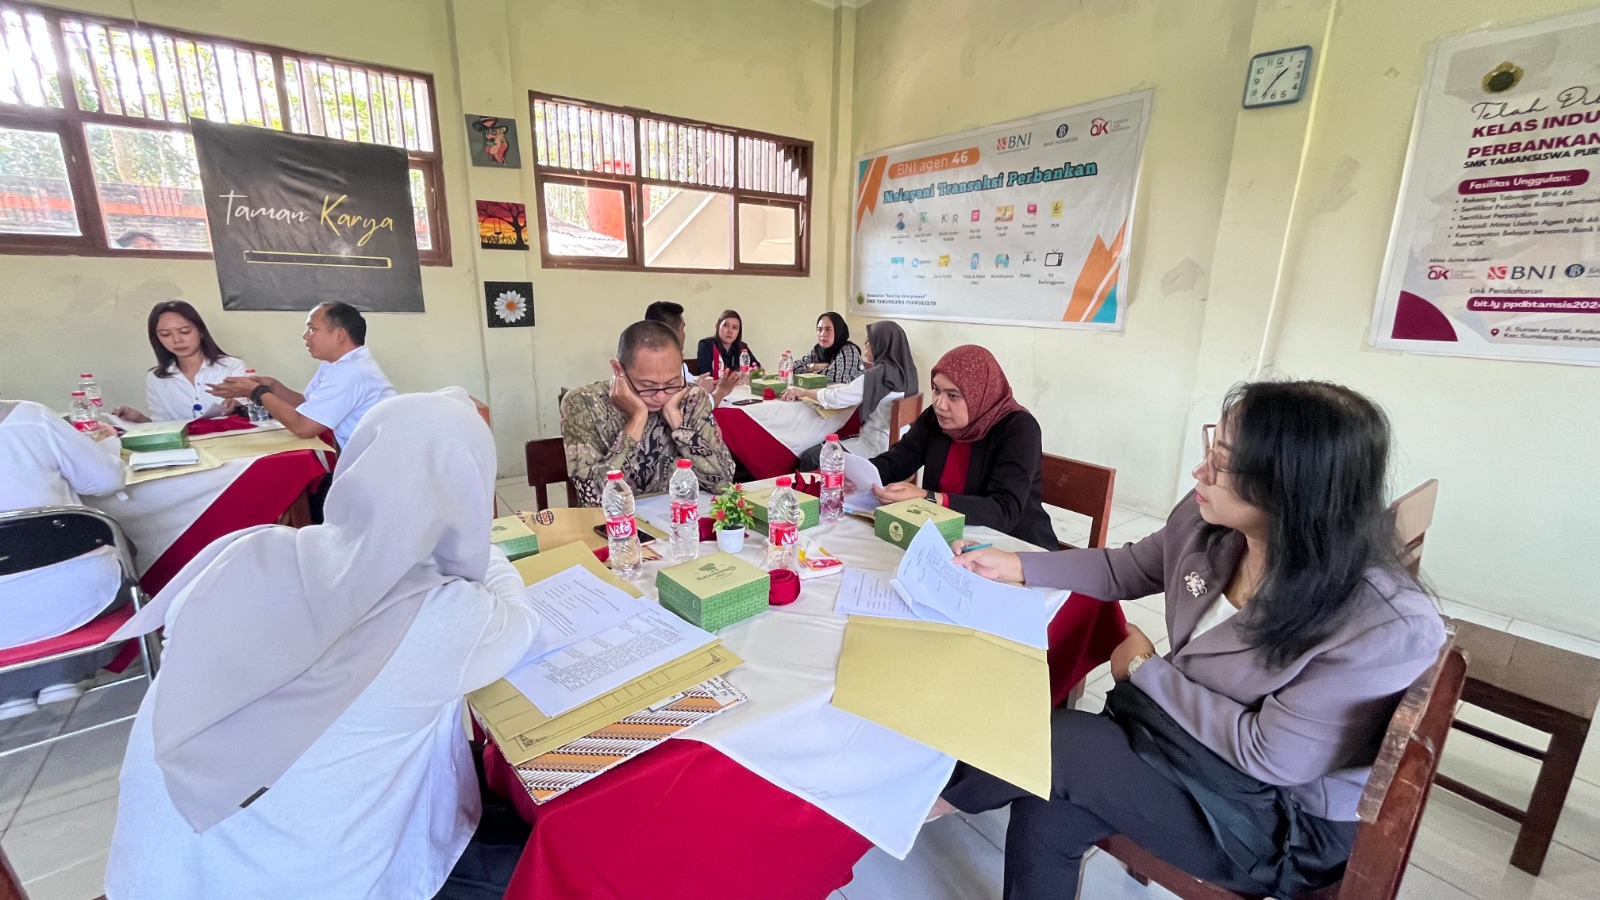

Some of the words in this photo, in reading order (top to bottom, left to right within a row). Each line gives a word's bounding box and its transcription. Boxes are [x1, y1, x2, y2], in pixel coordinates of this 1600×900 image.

[1297, 60, 1304, 68] 2
[1294, 72, 1301, 80] 3
[1280, 90, 1287, 98] 5
[1291, 82, 1298, 90] 4
[1270, 92, 1276, 100] 6
[1471, 98, 1548, 120] Telah
[1472, 118, 1538, 138] KELAS
[1008, 132, 1032, 149] BNI
[897, 161, 917, 176] BNI
[920, 157, 948, 173] agen
[952, 150, 969, 165] 46
[1463, 158, 1486, 169] SMK
[1490, 150, 1571, 165] TAMANSISWA
[883, 183, 935, 203] Melayani
[937, 173, 1004, 196] Transaksi
[1006, 160, 1098, 187] Perbankan
[1469, 180, 1510, 190] Fasilitas
[1513, 174, 1571, 187] Unggulan:
[219, 189, 309, 226] Taman
[320, 194, 393, 247] Karya
[1510, 265, 1557, 280] BNI
[1470, 287, 1486, 295] Link
[1488, 287, 1543, 295] Pendaftaran
